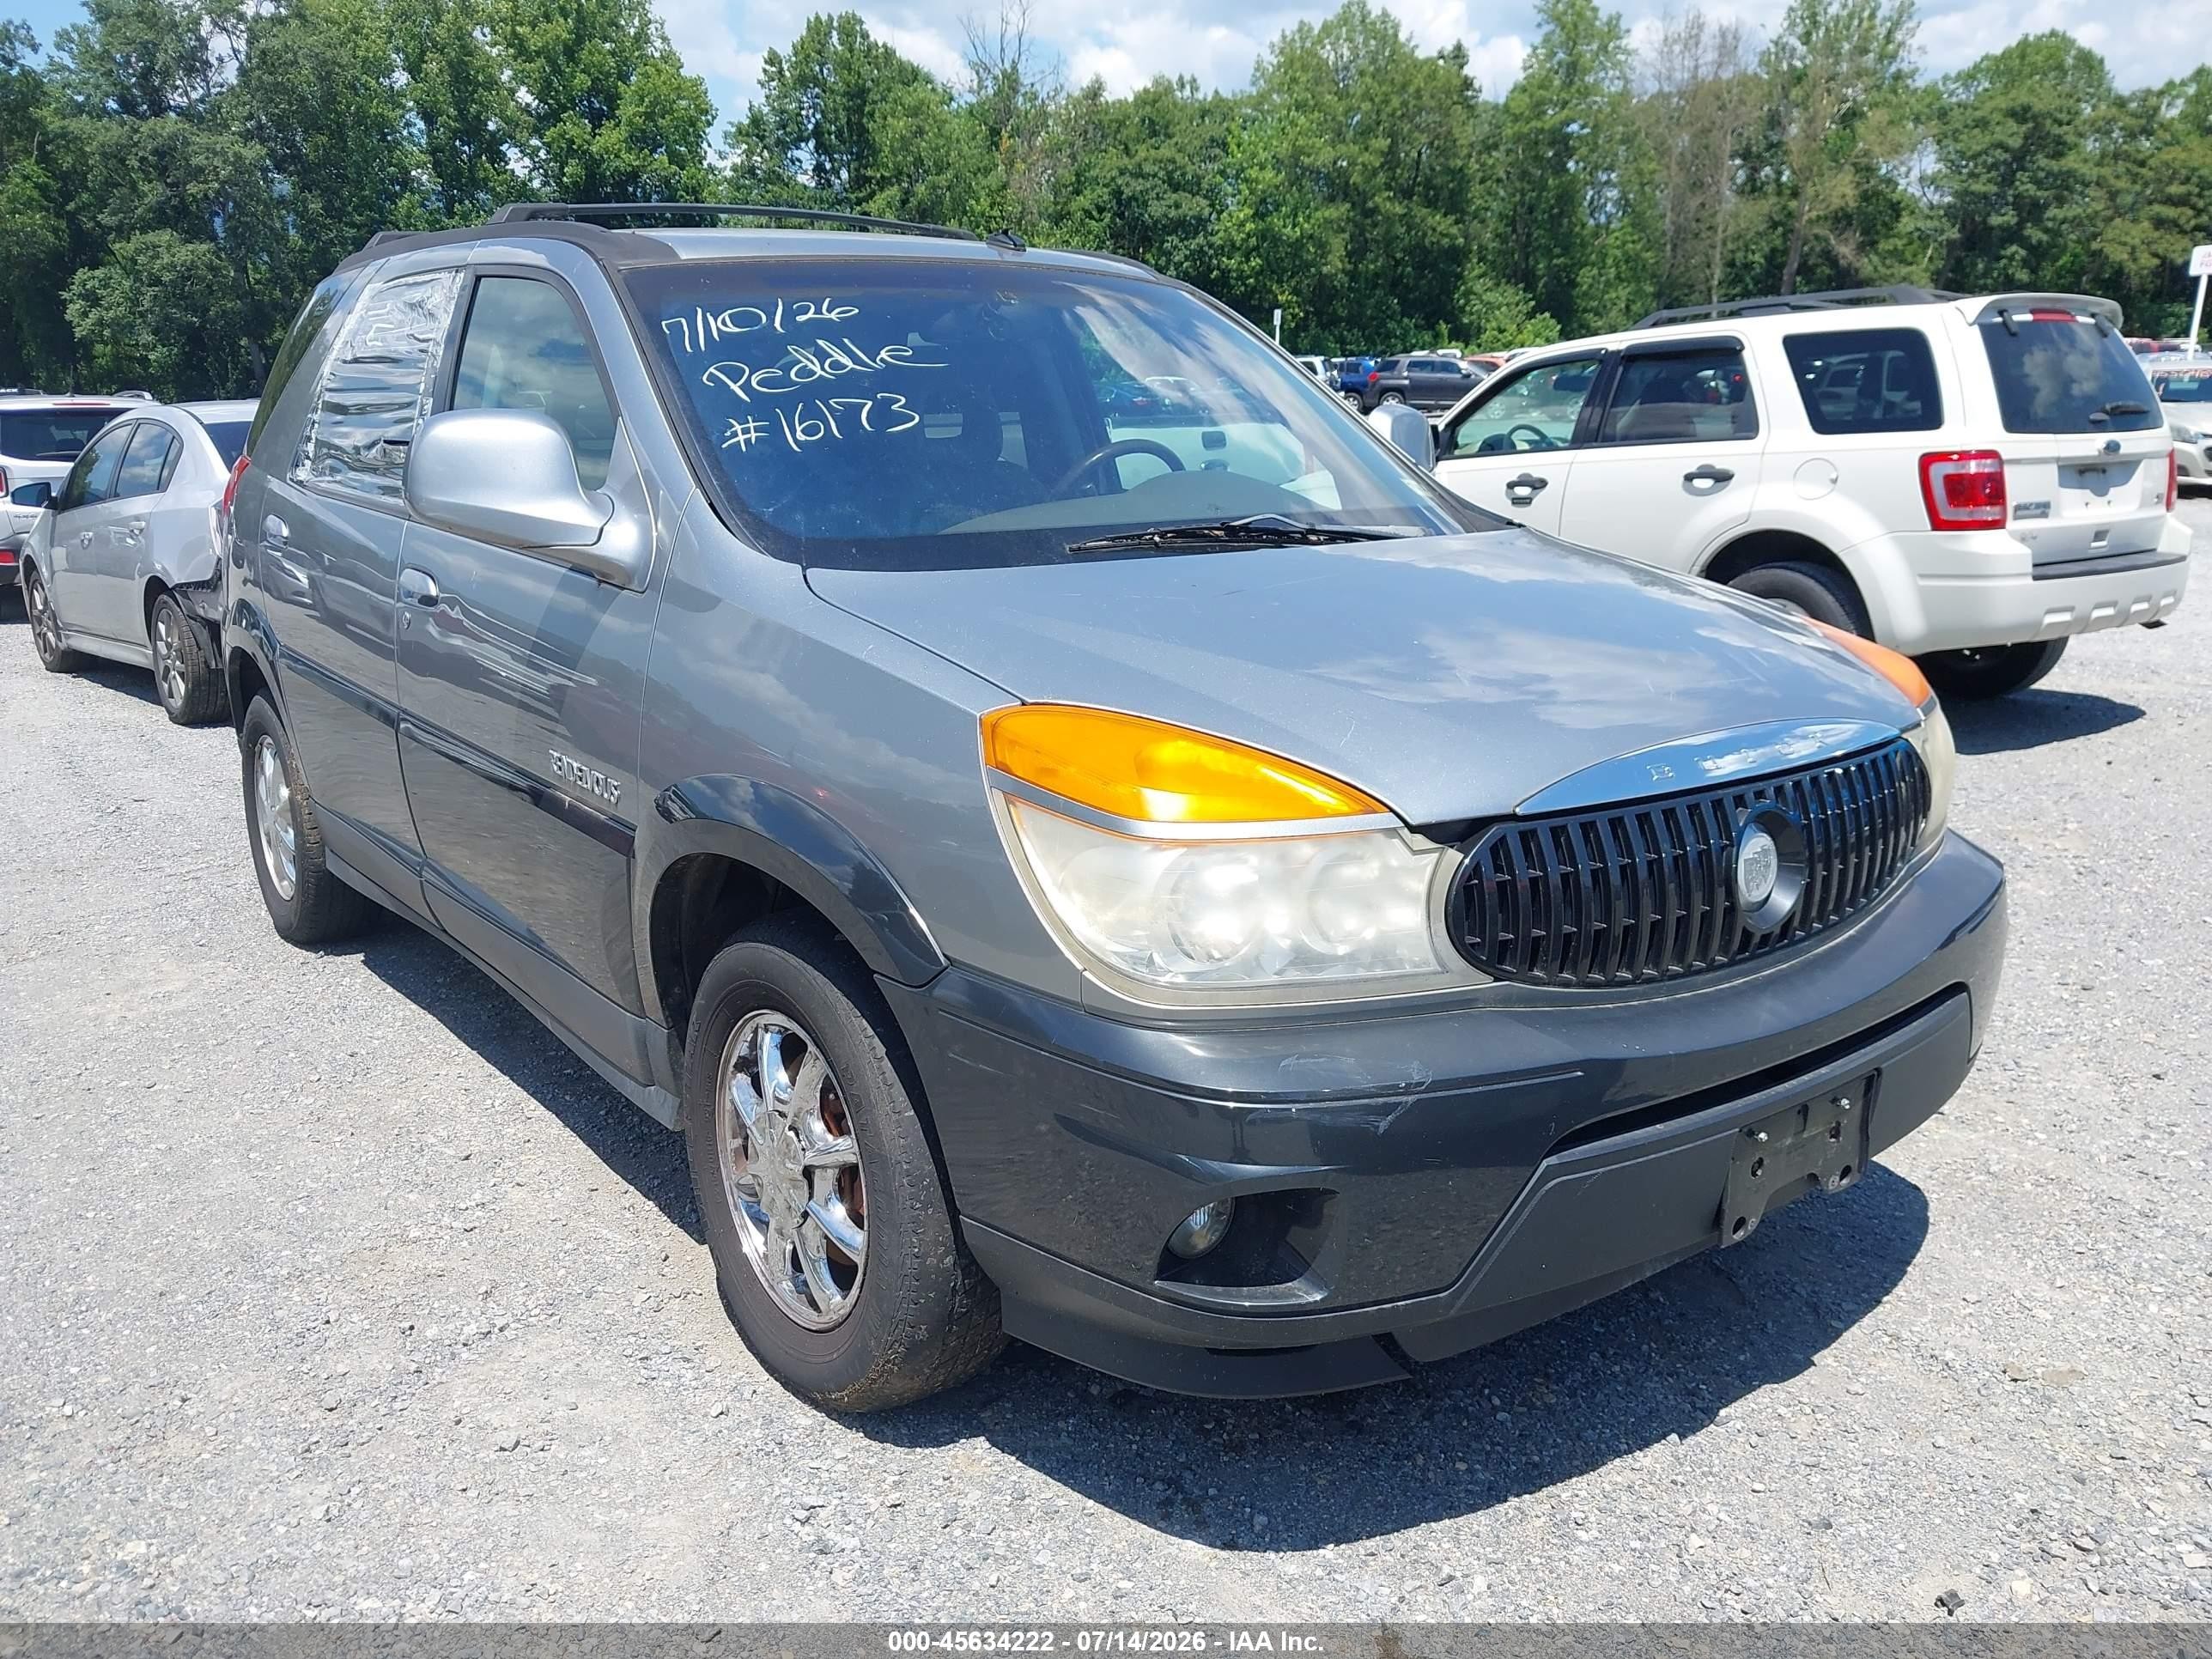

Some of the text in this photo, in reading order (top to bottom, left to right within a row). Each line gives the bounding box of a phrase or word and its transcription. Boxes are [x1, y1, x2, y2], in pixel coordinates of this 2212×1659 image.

[661, 297, 860, 352] 7/10/26
[702, 337, 950, 403] Peddle
[720, 392, 921, 453] #16173
